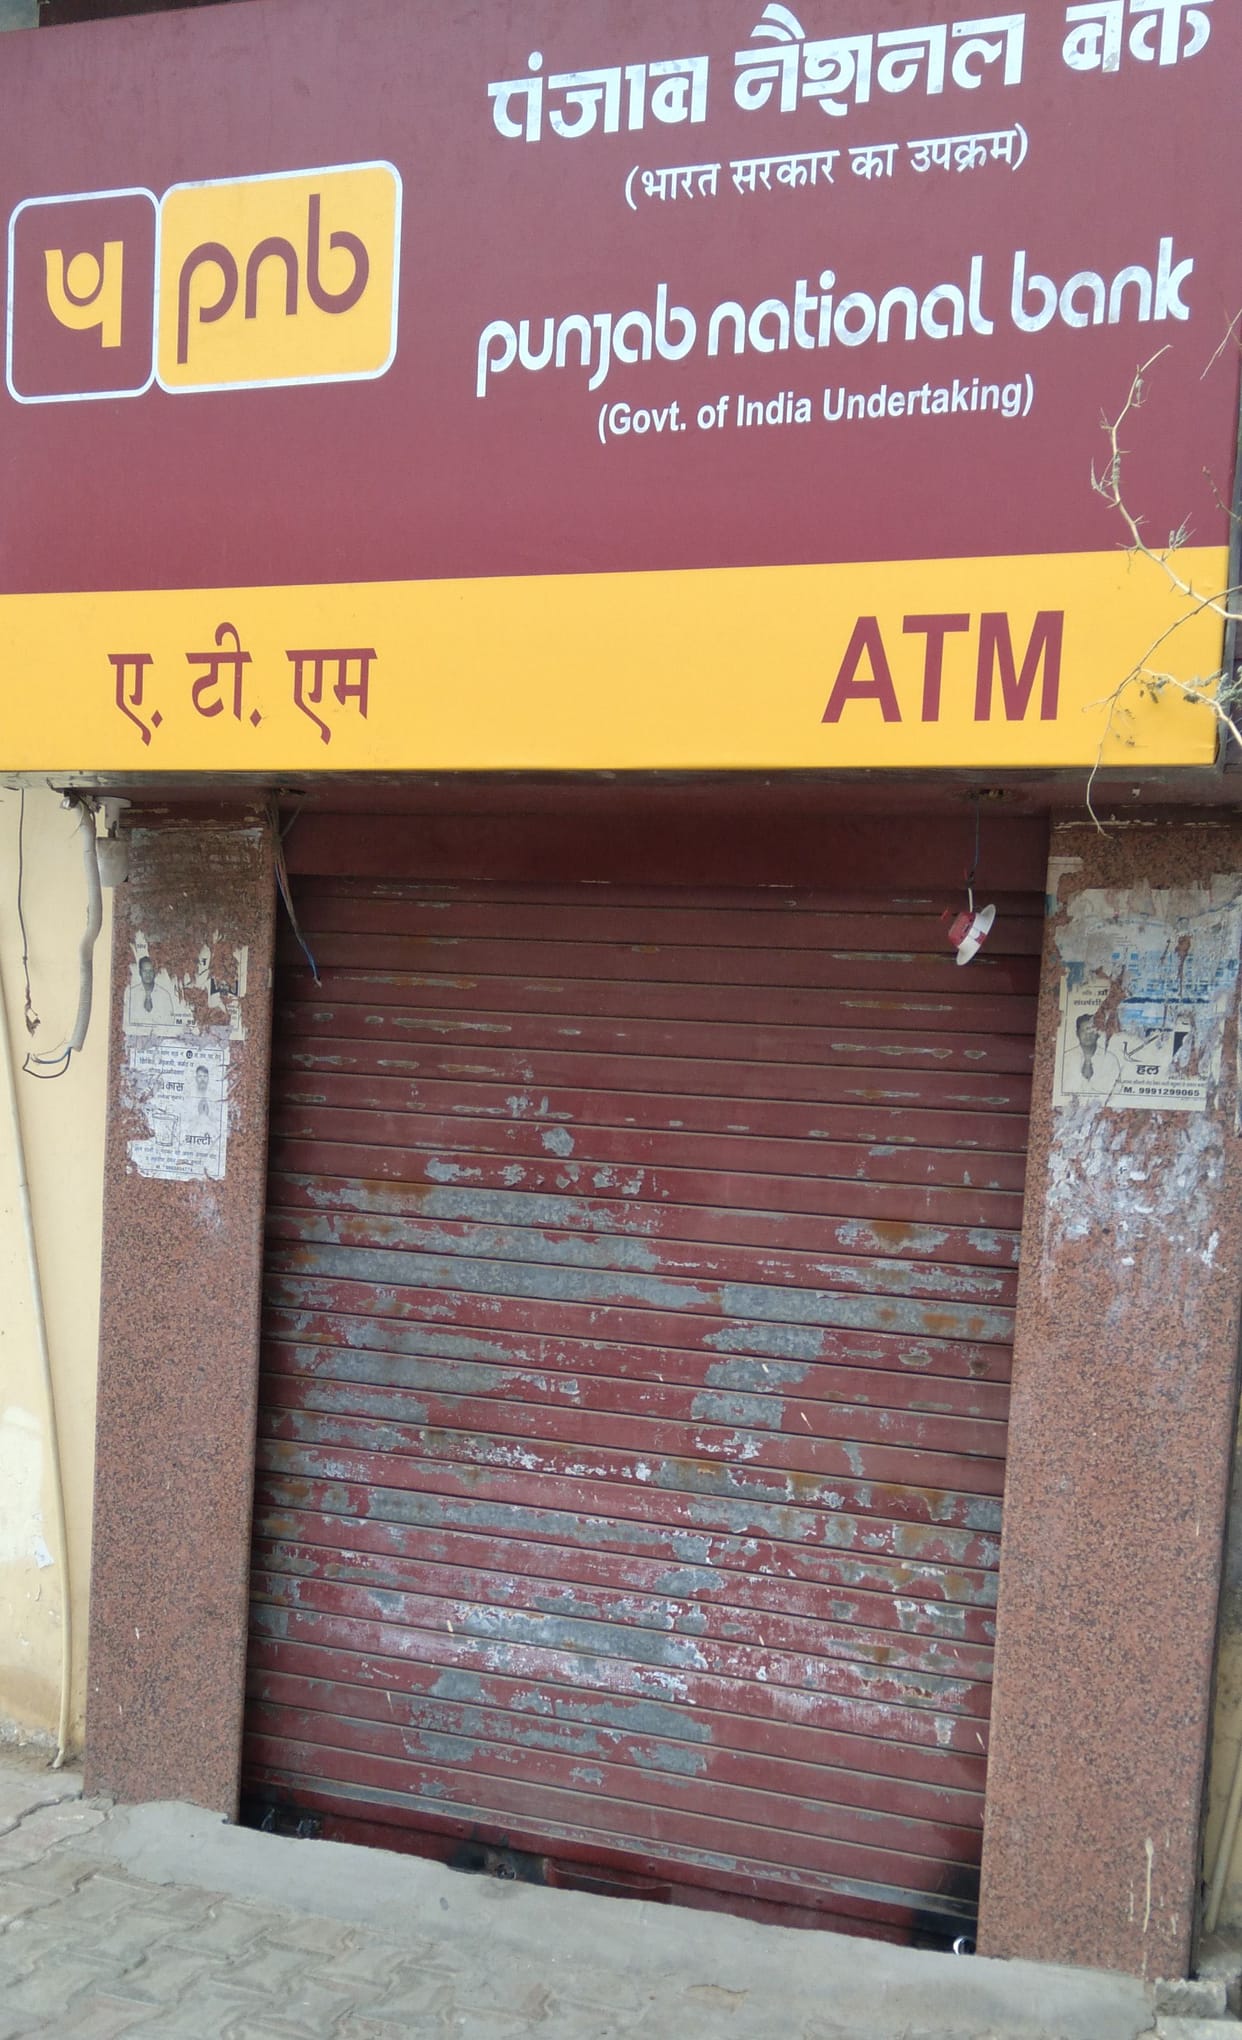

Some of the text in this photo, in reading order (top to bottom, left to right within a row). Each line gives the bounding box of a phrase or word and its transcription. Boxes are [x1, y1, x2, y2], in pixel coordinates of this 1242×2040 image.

[487, 0, 1212, 142] पंजाब नैशनल बक
[625, 123, 1028, 210] (भारत सरकार का उपक्रम)
[177, 193, 370, 365] pnb
[476, 236, 1194, 398] punjab national bank
[598, 373, 1034, 445] (Govt. of India Undertaking)
[285, 647, 378, 745] एम
[821, 610, 1065, 723] ATM
[1136, 1064, 1160, 1075] हल
